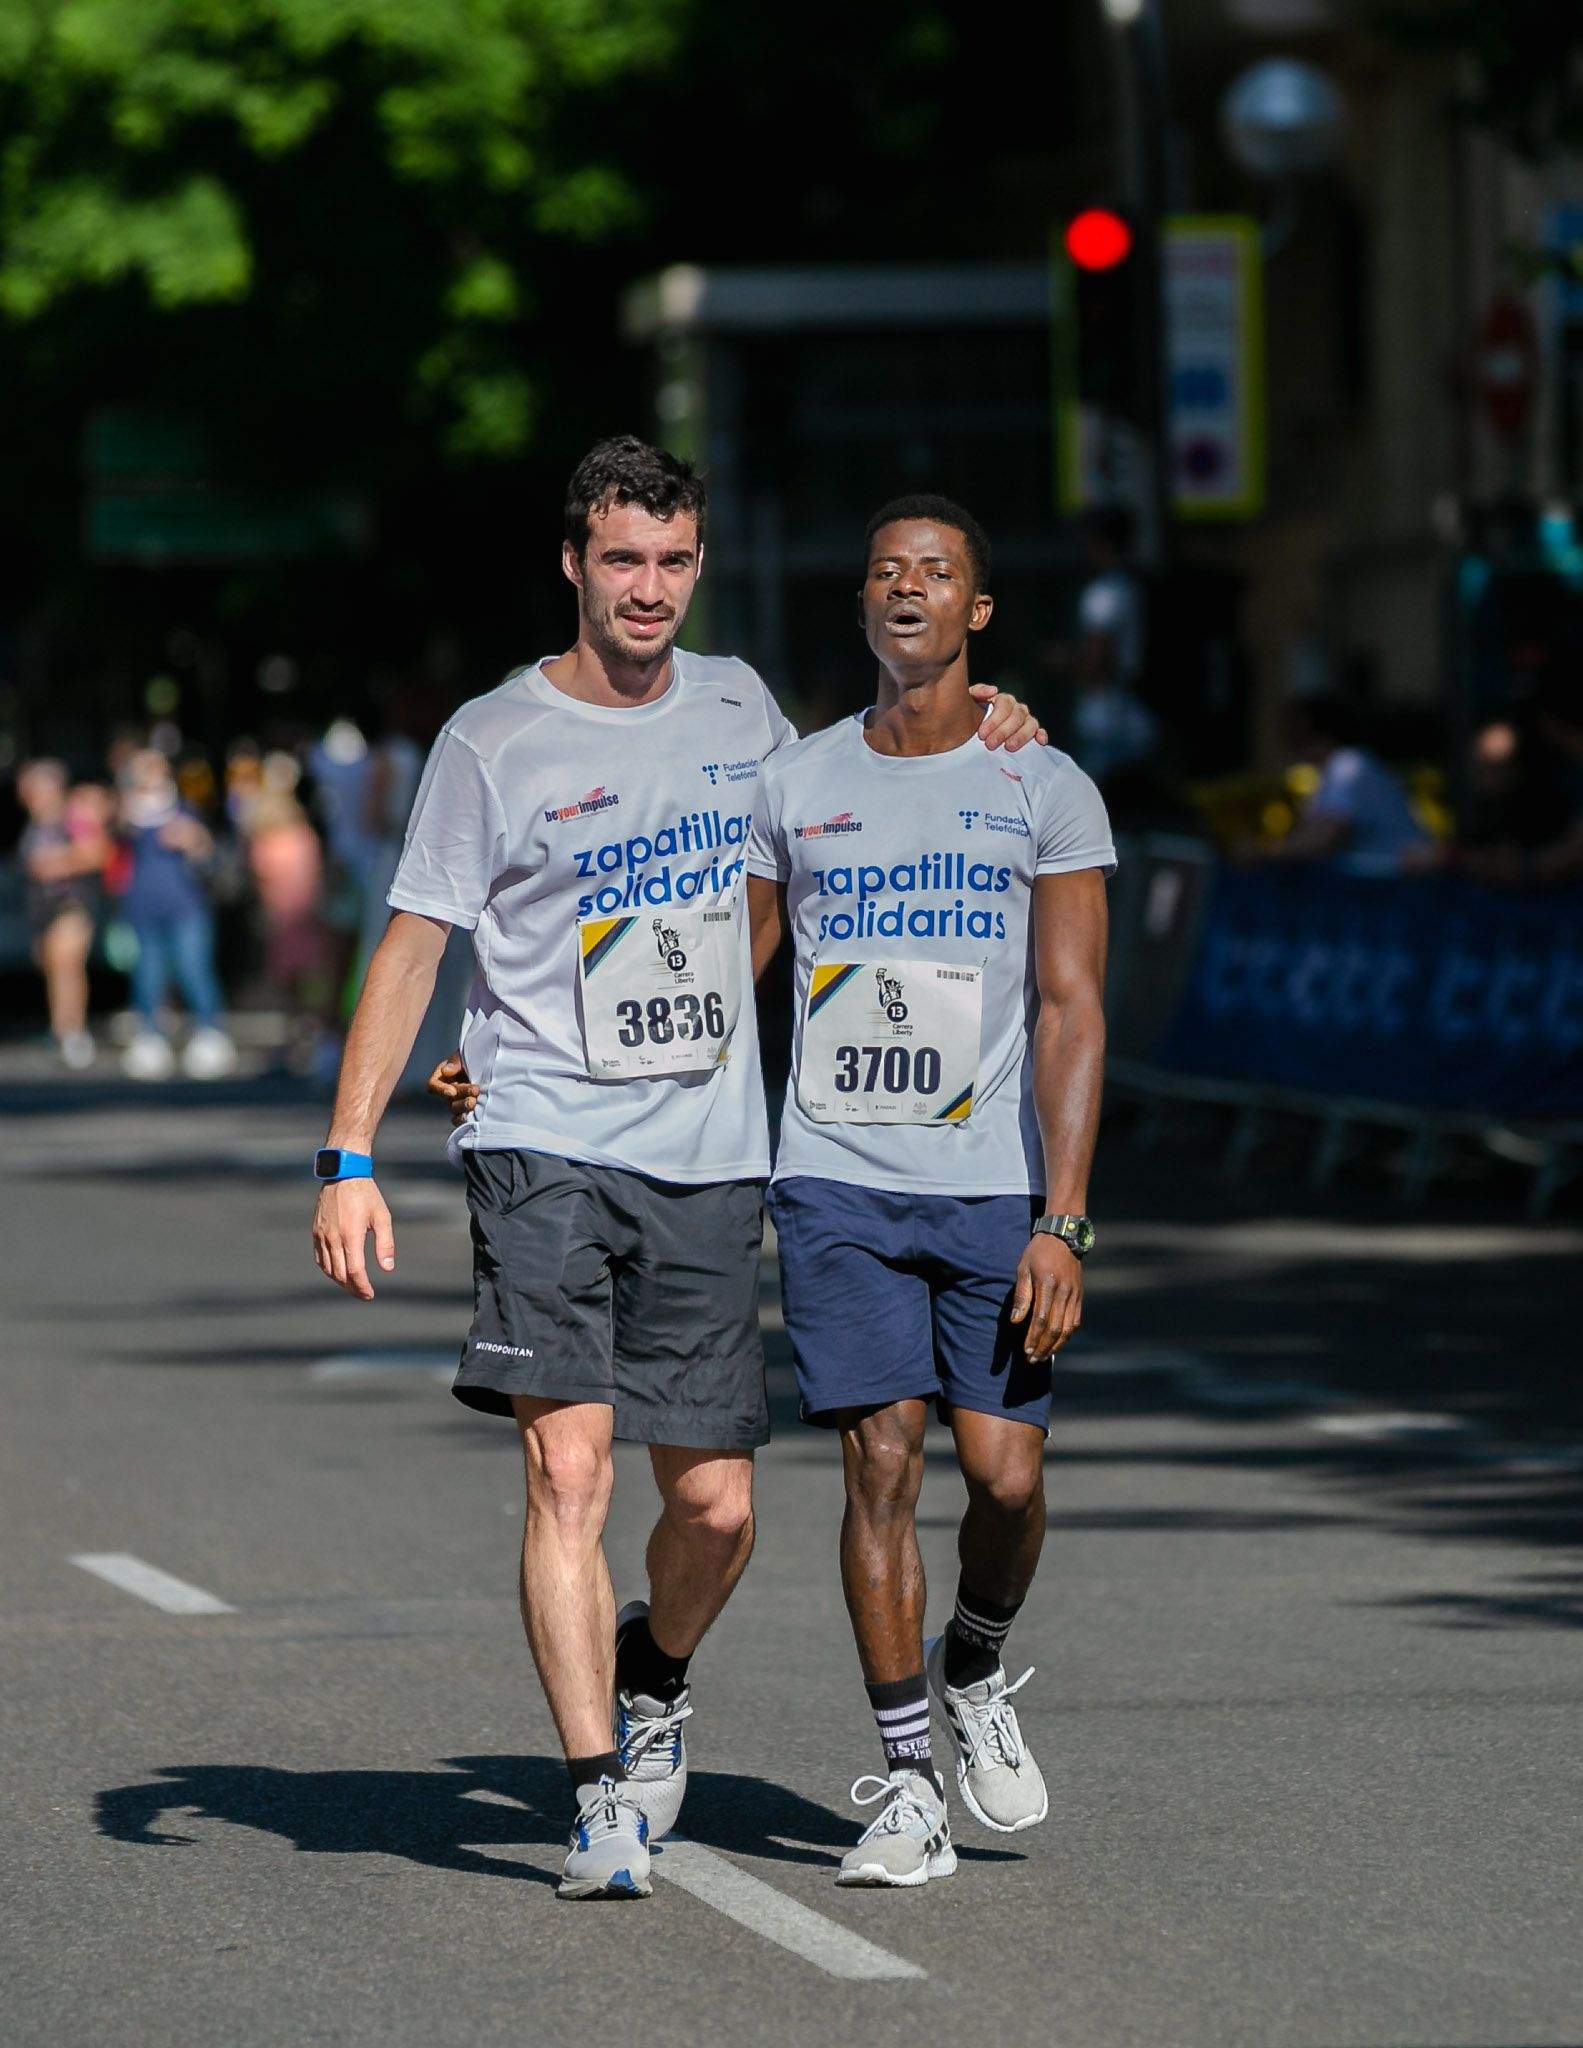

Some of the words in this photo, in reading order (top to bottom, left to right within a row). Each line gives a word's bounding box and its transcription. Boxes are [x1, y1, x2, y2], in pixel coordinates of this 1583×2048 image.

[544, 793, 619, 822] beyourimpulse
[818, 900, 1006, 941] solidarias
[670, 954, 684, 967] 13
[616, 991, 725, 1048] 3836
[890, 1005, 904, 1018] 13
[834, 1045, 941, 1095] 3700
